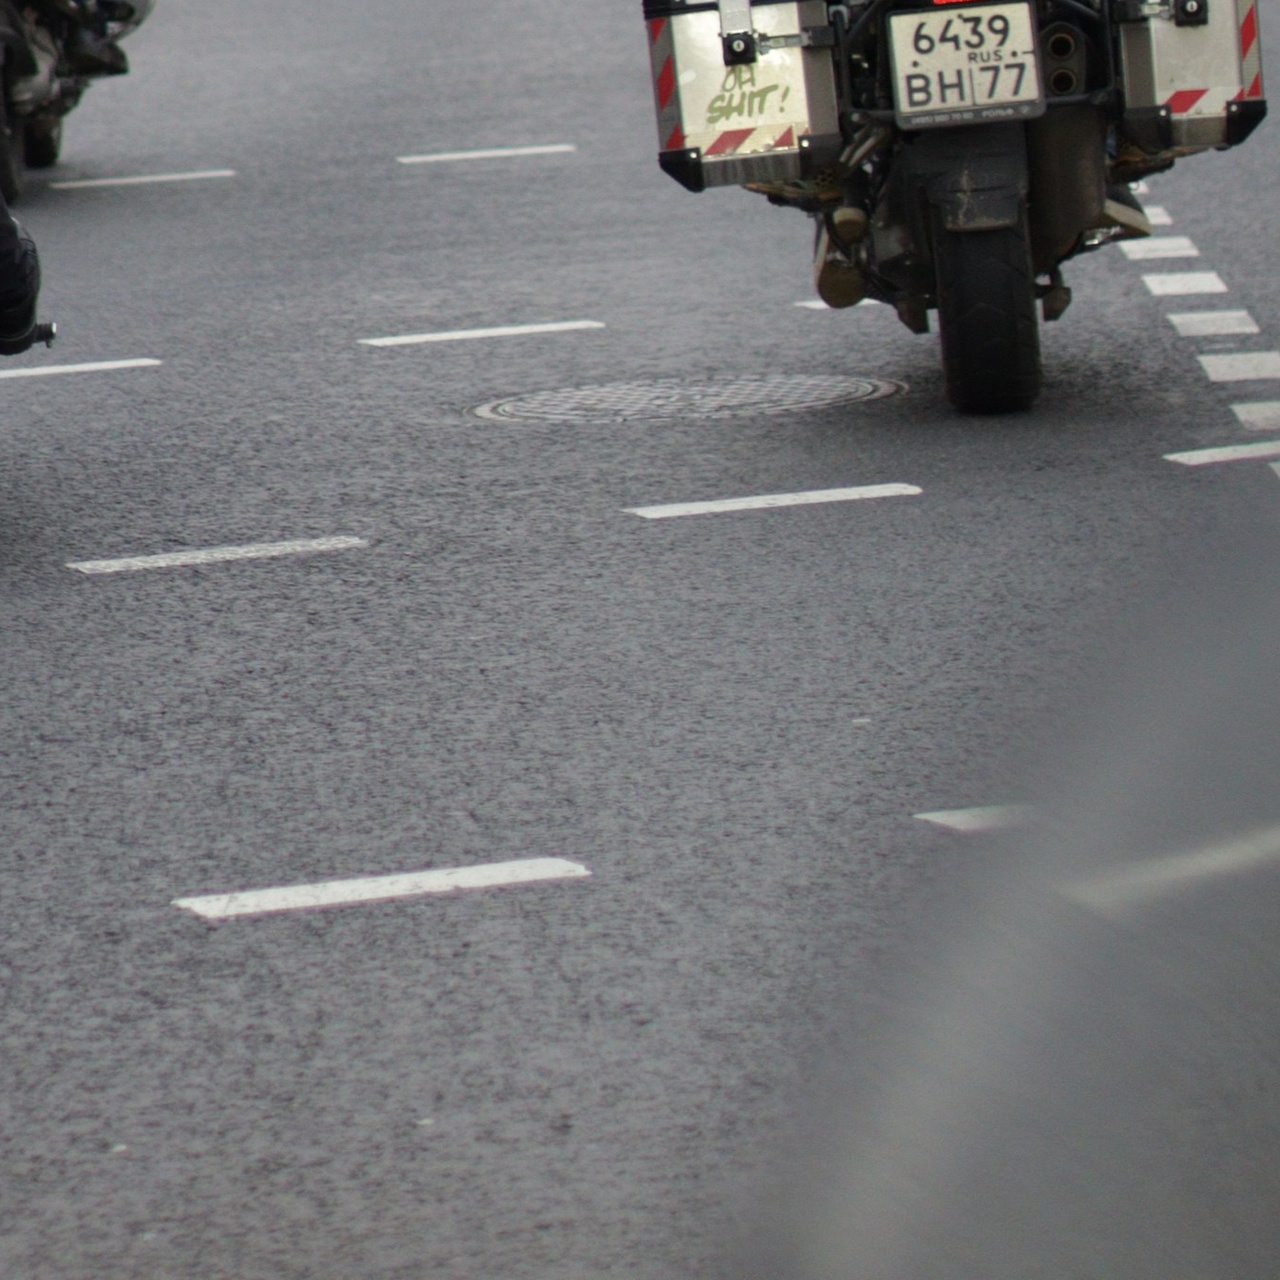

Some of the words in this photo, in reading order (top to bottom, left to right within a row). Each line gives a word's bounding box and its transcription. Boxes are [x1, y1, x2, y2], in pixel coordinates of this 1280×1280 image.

[913, 15, 1010, 54] 6439
[968, 50, 1003, 63] RUS
[979, 62, 1026, 99] 77
